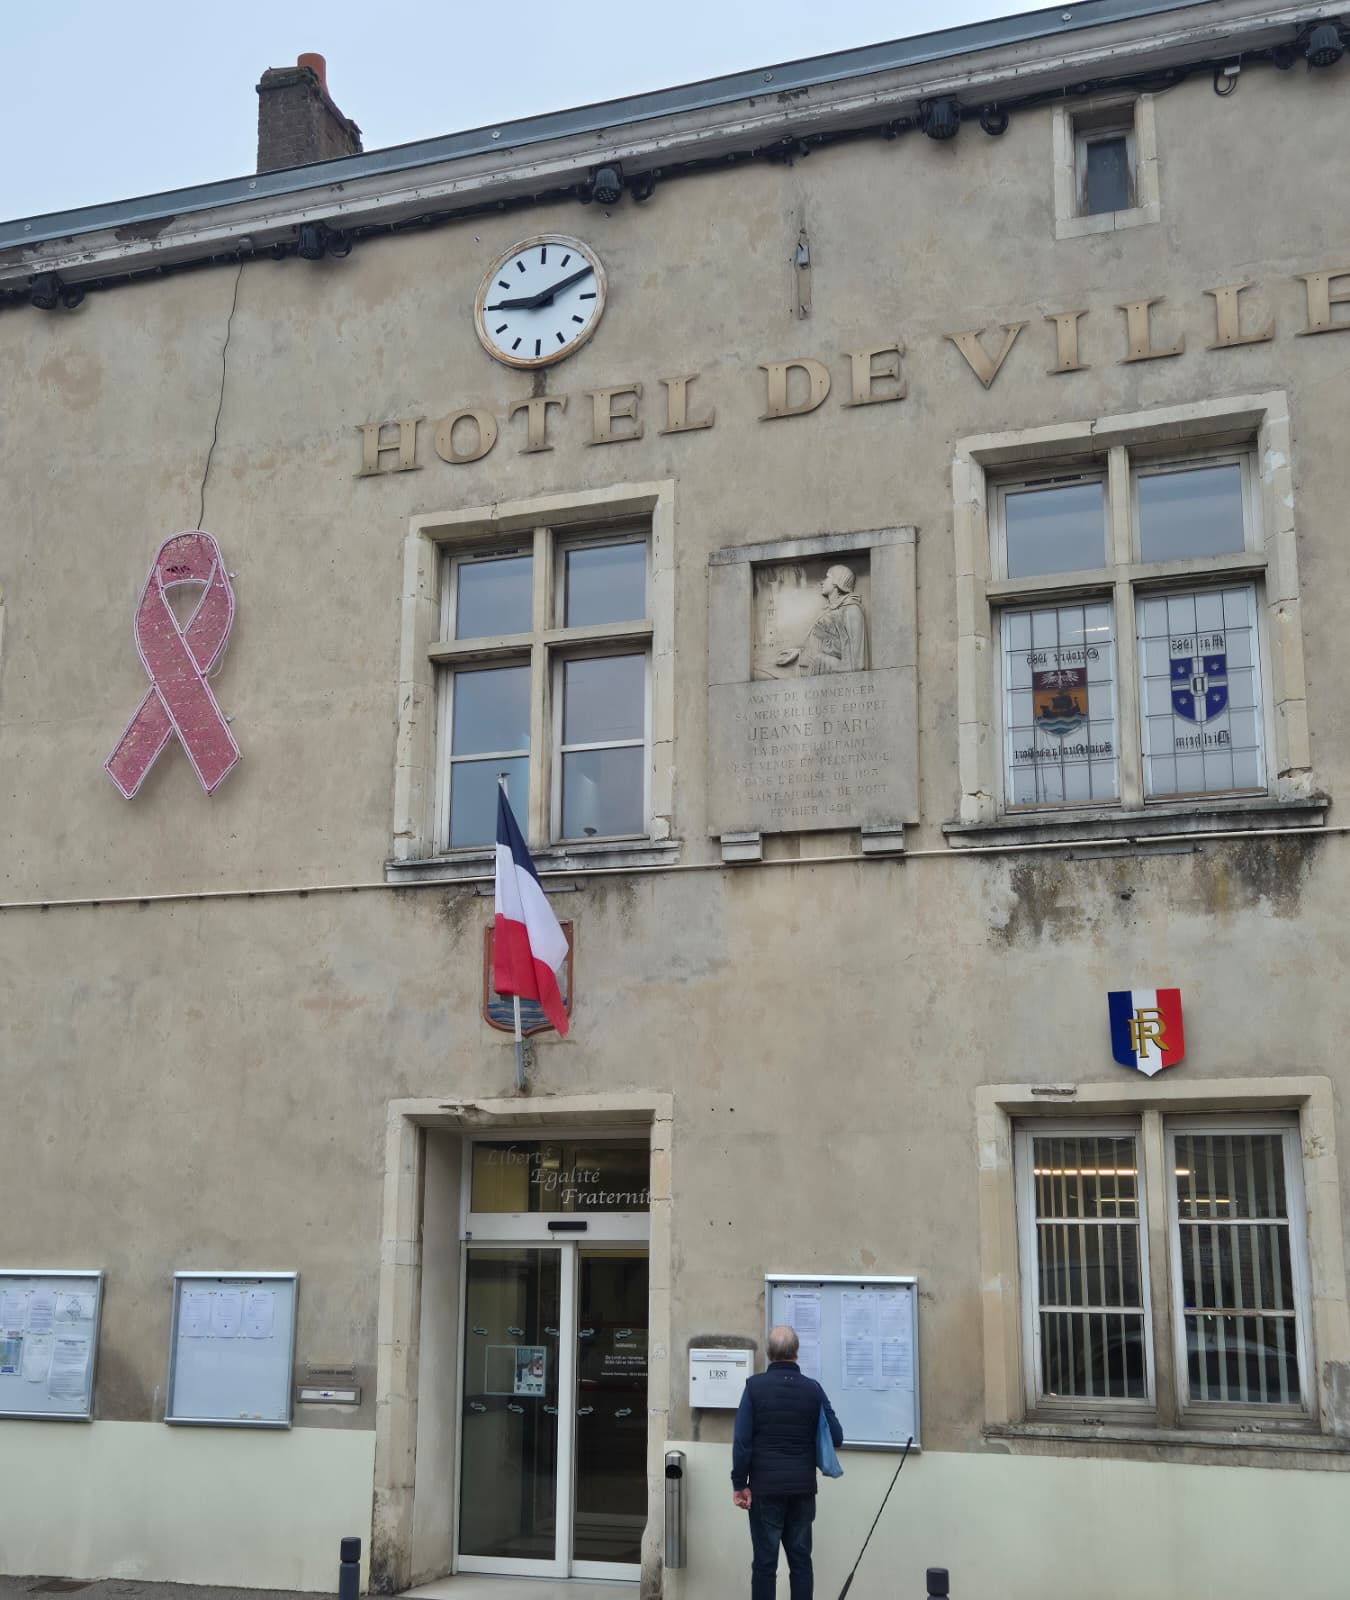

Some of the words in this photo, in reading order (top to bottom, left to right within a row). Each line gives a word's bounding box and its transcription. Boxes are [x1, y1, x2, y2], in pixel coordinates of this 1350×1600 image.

[353, 372, 716, 478] HOTEL
[757, 342, 907, 422] DE
[942, 266, 1350, 390] VILLE
[784, 691, 797, 701] DE
[748, 722, 813, 741] JEANNE
[488, 1145, 551, 1165] Liberté
[530, 1166, 601, 1192] Egalité
[560, 1187, 650, 1205] Fraternit
[709, 1369, 728, 1377] L'EST
